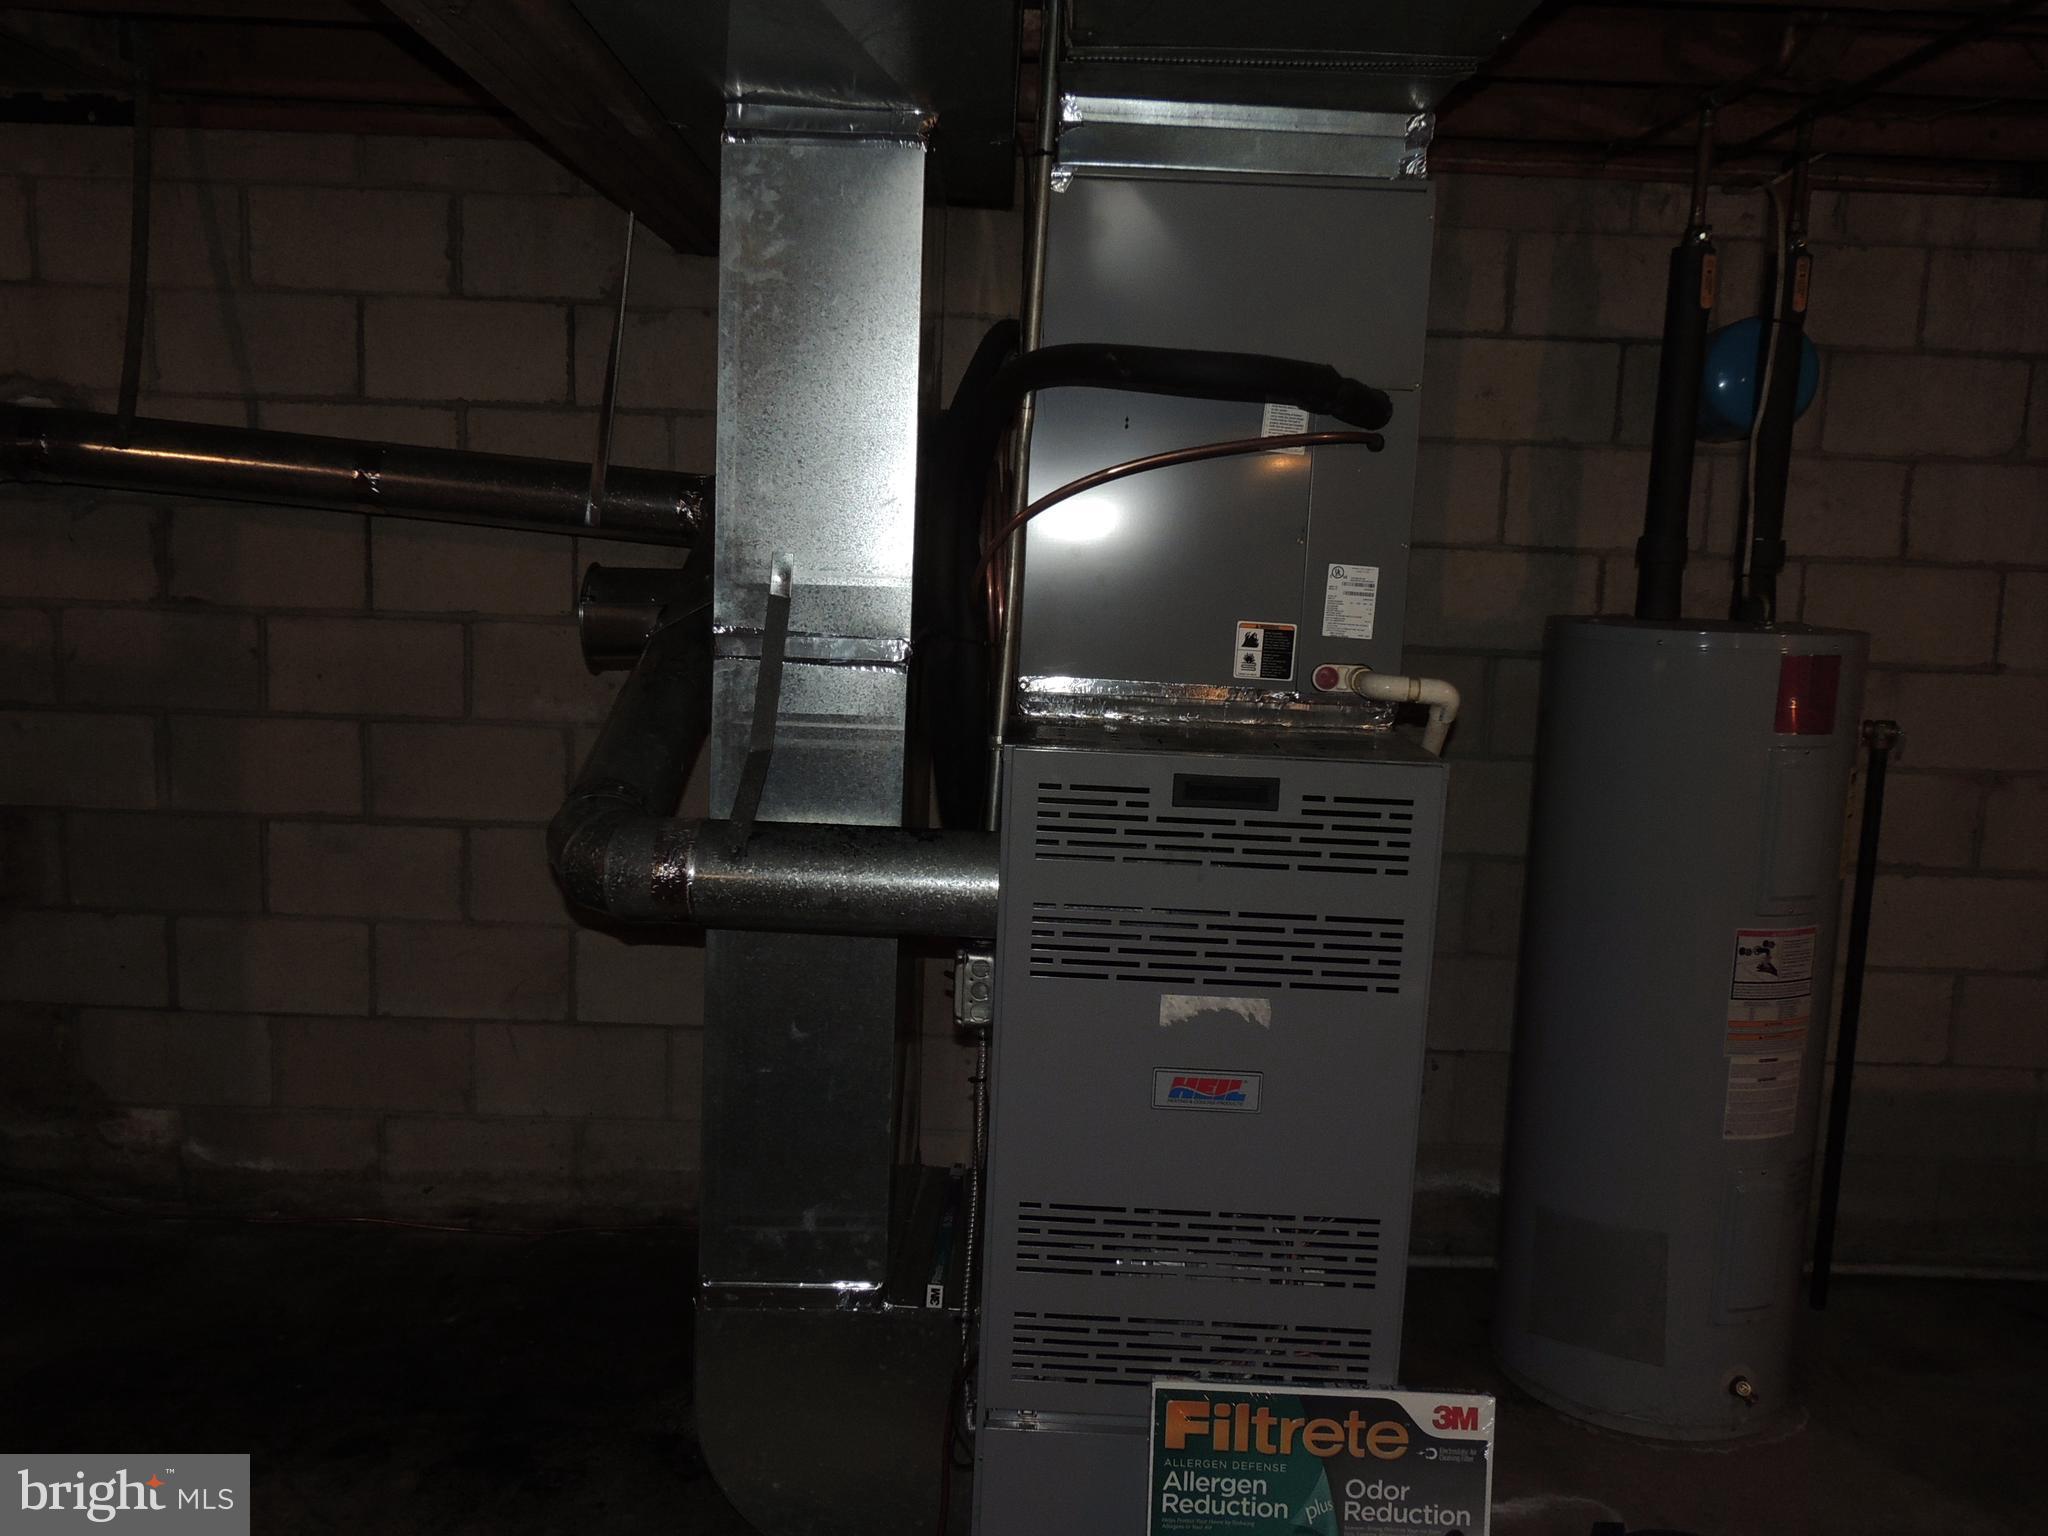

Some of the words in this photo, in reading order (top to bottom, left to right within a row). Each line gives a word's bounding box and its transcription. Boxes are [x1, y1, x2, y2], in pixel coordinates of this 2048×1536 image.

[930, 1288, 941, 1306] 3M
[1164, 1399, 1409, 1460] Filtrete
[1432, 1405, 1478, 1431] 3M
[1164, 1458, 1227, 1469] ALLERGEN
[1232, 1461, 1288, 1473] DEFENSE
[1162, 1470, 1267, 1497] Allergen
[1345, 1478, 1410, 1501] Odor
[1162, 1493, 1289, 1519] Reduction
[1305, 1499, 1334, 1524] plus
[1344, 1501, 1471, 1526] Reduction
